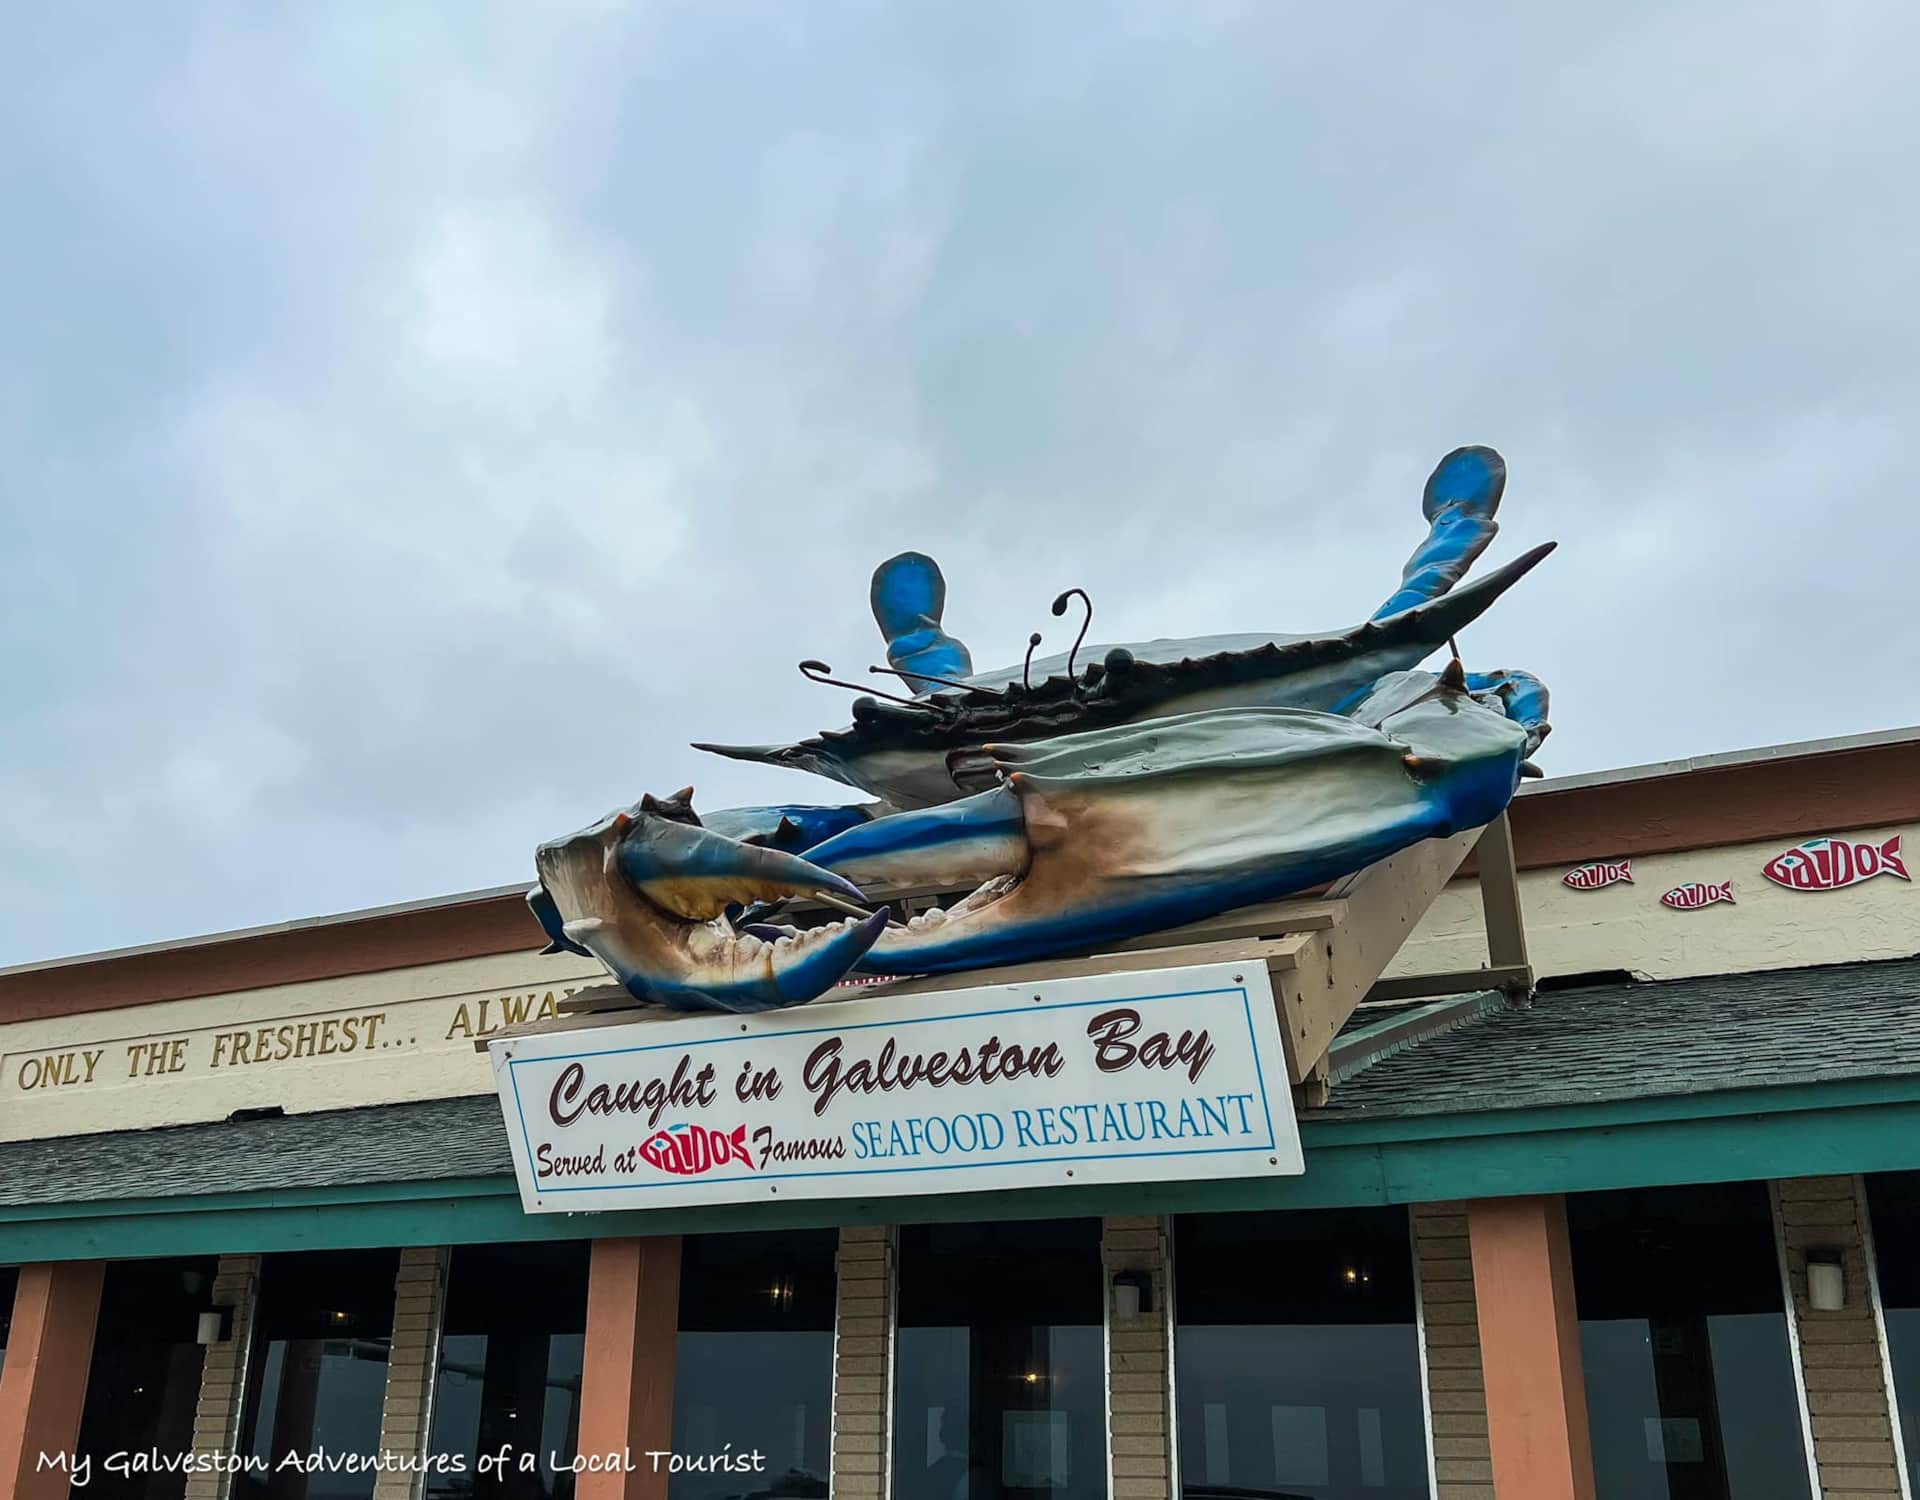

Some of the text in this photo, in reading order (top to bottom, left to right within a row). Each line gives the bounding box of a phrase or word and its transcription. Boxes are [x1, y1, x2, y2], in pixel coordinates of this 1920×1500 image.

[18, 1050, 104, 1089] ONLY
[127, 1039, 189, 1077] THE
[549, 1008, 1216, 1130] Caught in Galveston Bay
[537, 1143, 605, 1179] Served
[614, 1144, 638, 1175] at
[752, 1125, 847, 1171] Famous
[852, 1113, 1005, 1160] SEAFOOD
[1012, 1092, 1255, 1148] RESTAURANT
